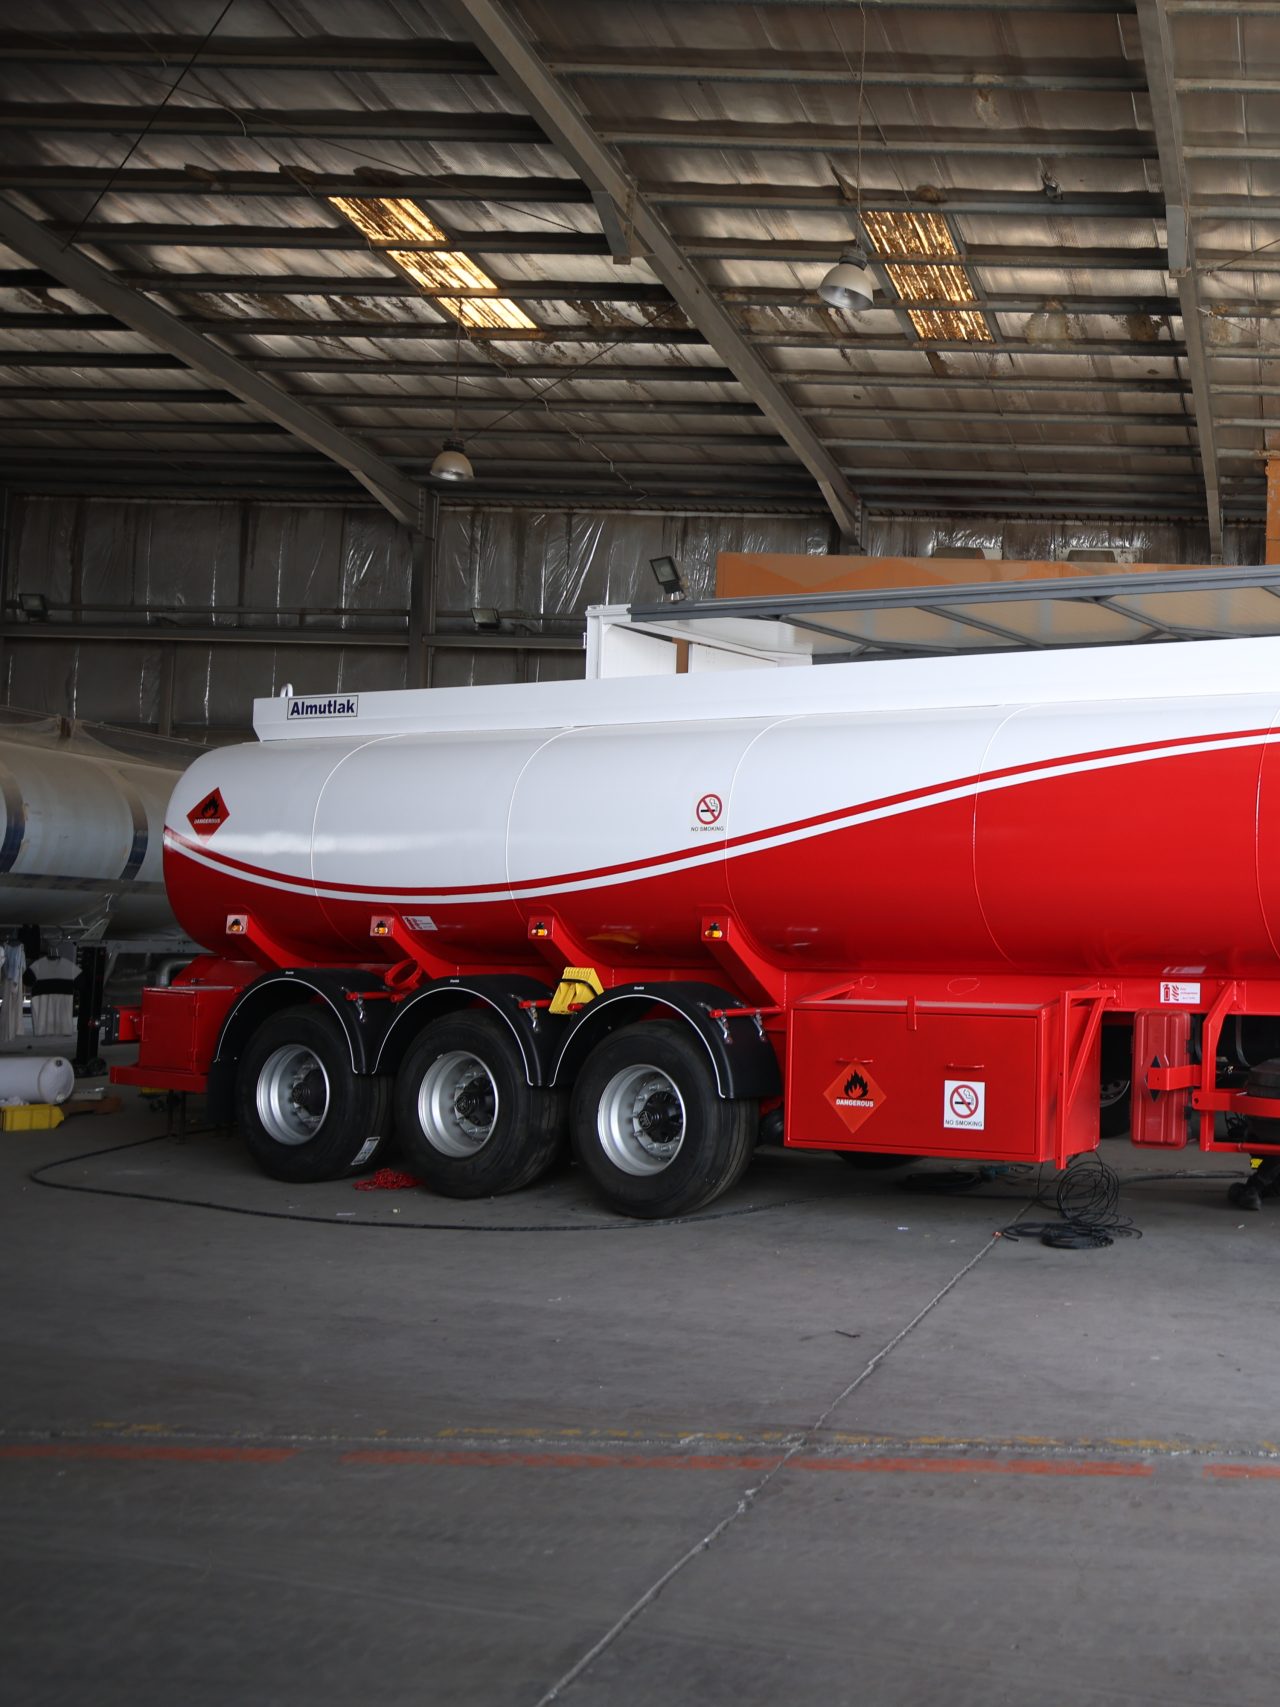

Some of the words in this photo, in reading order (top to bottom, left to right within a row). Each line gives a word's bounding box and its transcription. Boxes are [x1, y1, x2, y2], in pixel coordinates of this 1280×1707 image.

[290, 698, 356, 716] Almutlak
[835, 1098, 874, 1108] DANGEROUS
[955, 1119, 983, 1128] SMOKING
